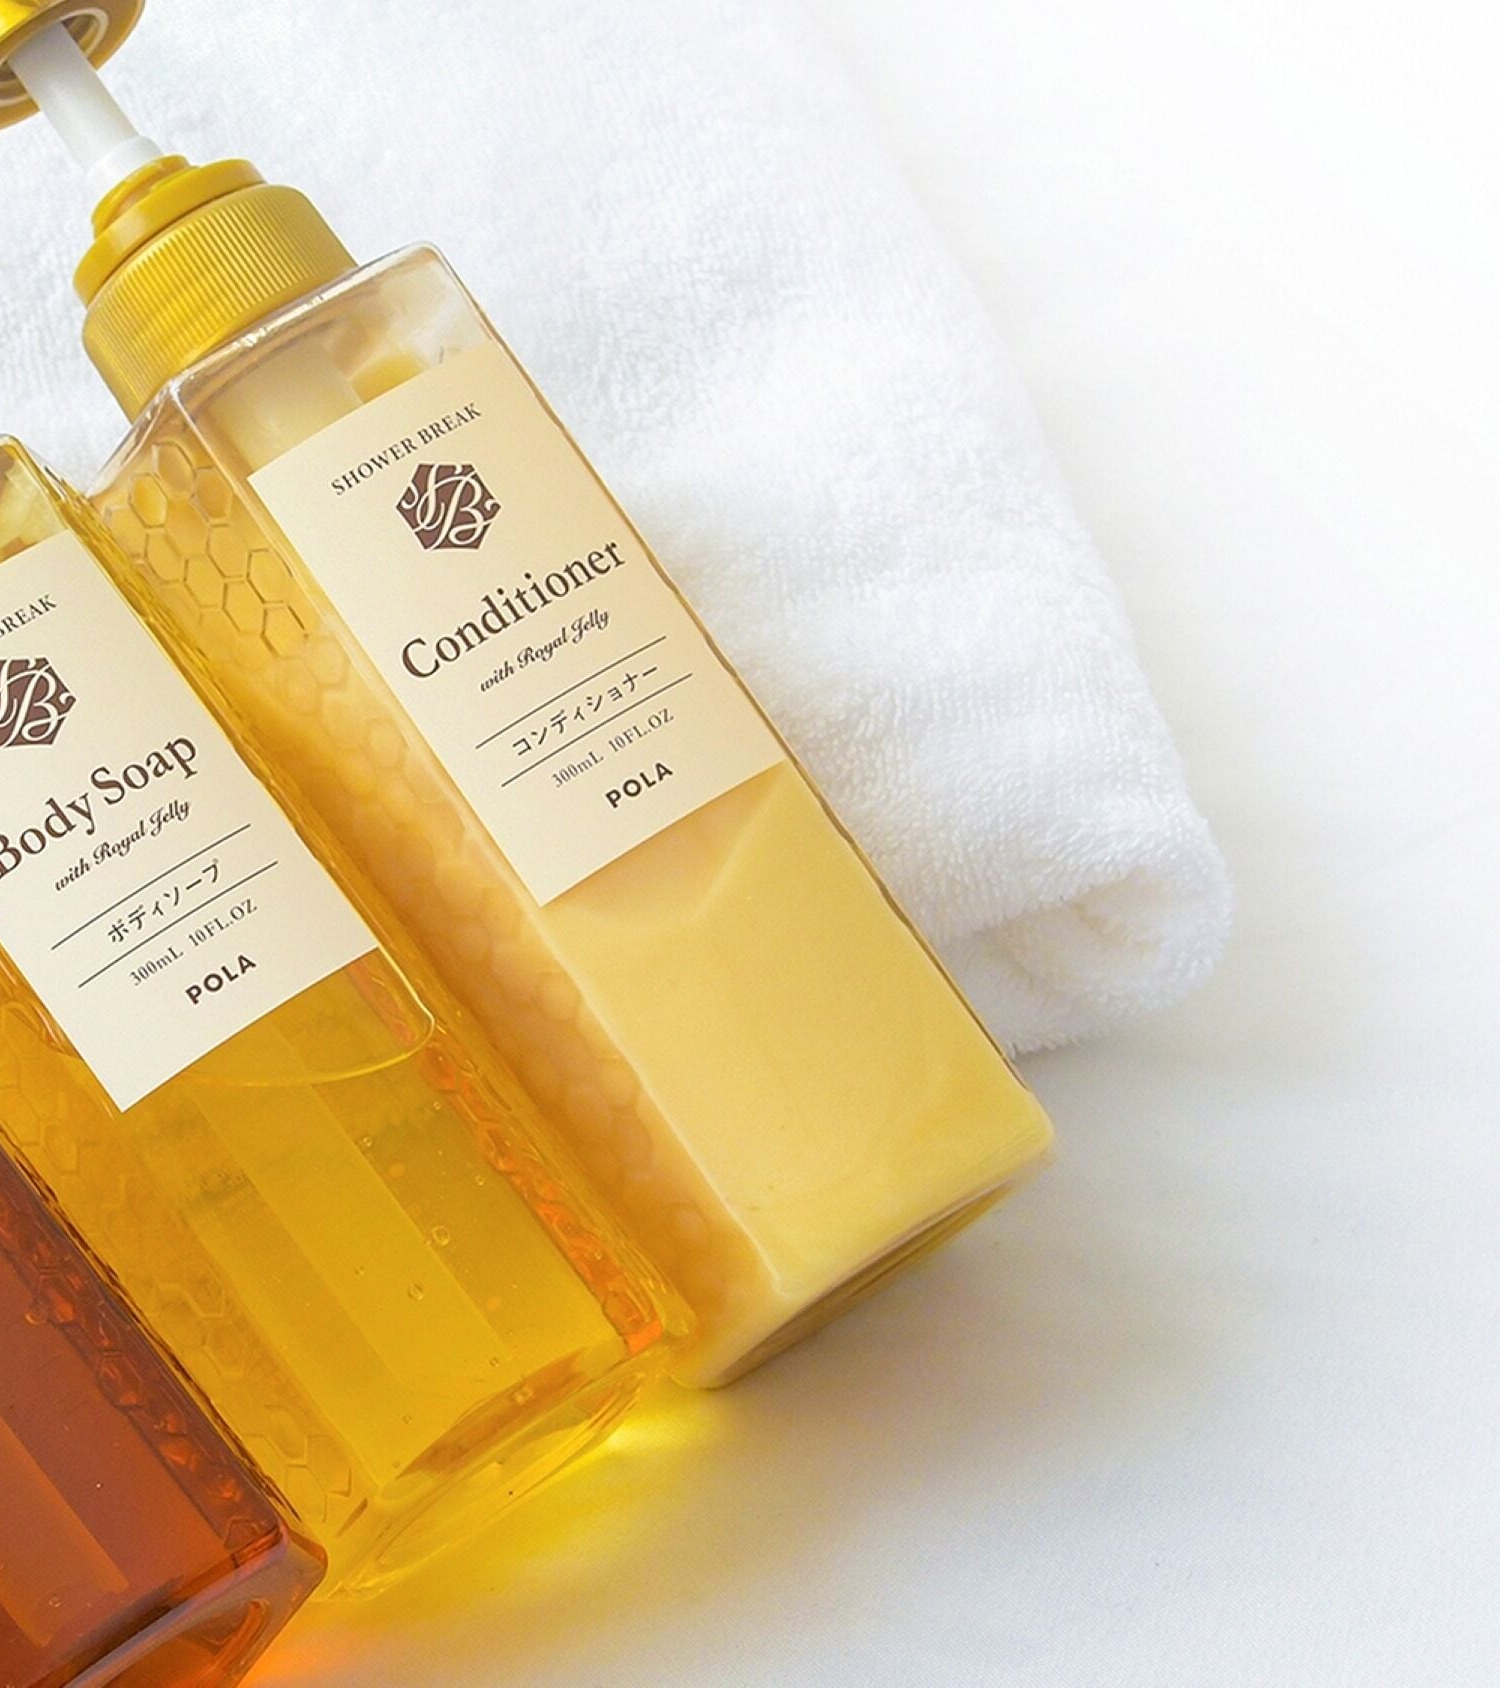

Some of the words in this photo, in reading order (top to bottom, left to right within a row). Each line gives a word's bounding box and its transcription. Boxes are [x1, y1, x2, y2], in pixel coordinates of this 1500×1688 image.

[331, 436, 418, 495] SHOWER
[417, 403, 482, 445] BREAK
[400, 541, 626, 678] Conditioner
[480, 660, 515, 692] with
[516, 628, 569, 669] Royal
[569, 608, 610, 644] Jelly
[512, 665, 658, 757] コンディショナー
[90, 737, 198, 809] Soap
[551, 751, 604, 789] 300mL
[605, 762, 673, 809] POLA
[55, 857, 92, 892] with
[92, 823, 147, 867] Royal
[149, 799, 191, 838] Jelly
[106, 857, 222, 944] ボディソープ
[130, 945, 184, 986] 300mL
[184, 953, 257, 1004] POLA
